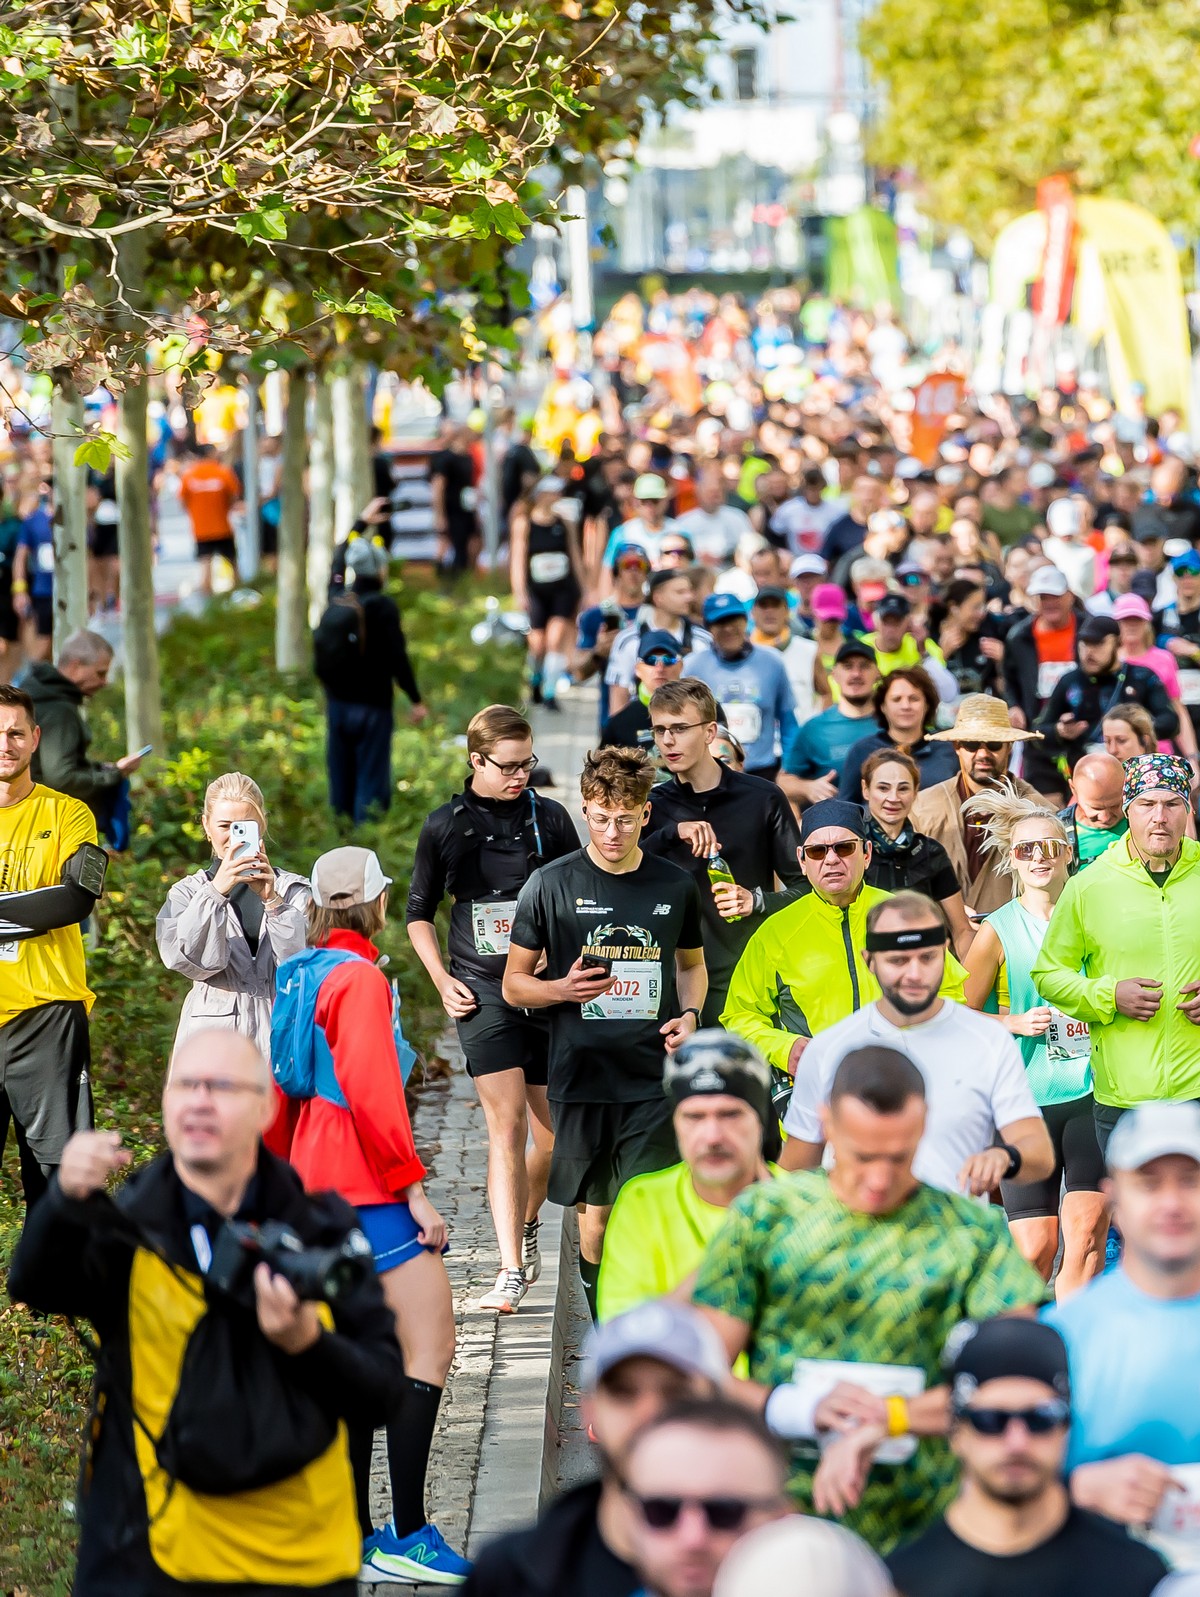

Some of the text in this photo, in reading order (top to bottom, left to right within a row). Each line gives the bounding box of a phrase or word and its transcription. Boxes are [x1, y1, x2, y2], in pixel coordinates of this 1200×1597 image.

[493, 919, 511, 934] 35
[581, 945, 661, 960] MARATON STULECIA
